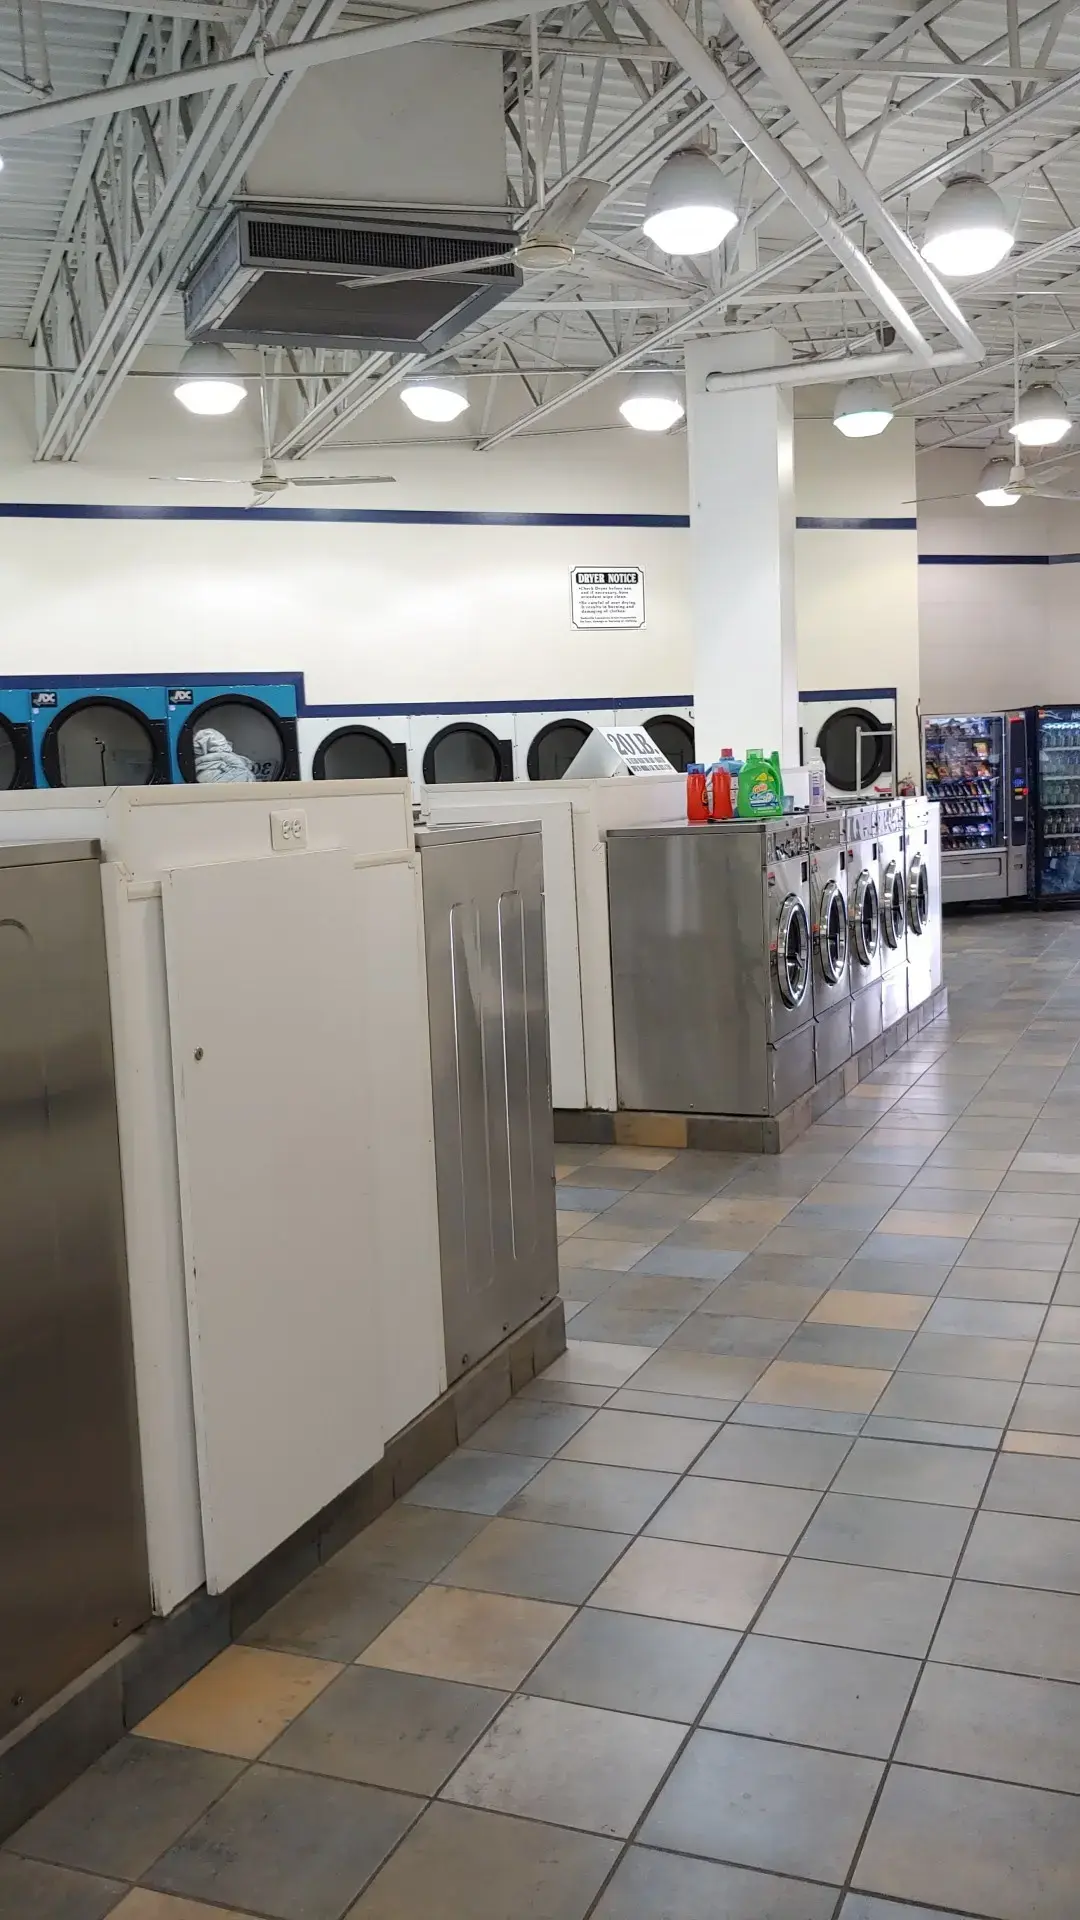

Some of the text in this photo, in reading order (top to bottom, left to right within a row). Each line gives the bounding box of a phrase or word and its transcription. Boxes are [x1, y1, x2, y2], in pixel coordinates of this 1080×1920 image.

[578, 573, 637, 583] DRYER NOTICE
[606, 733, 636, 755] 20
